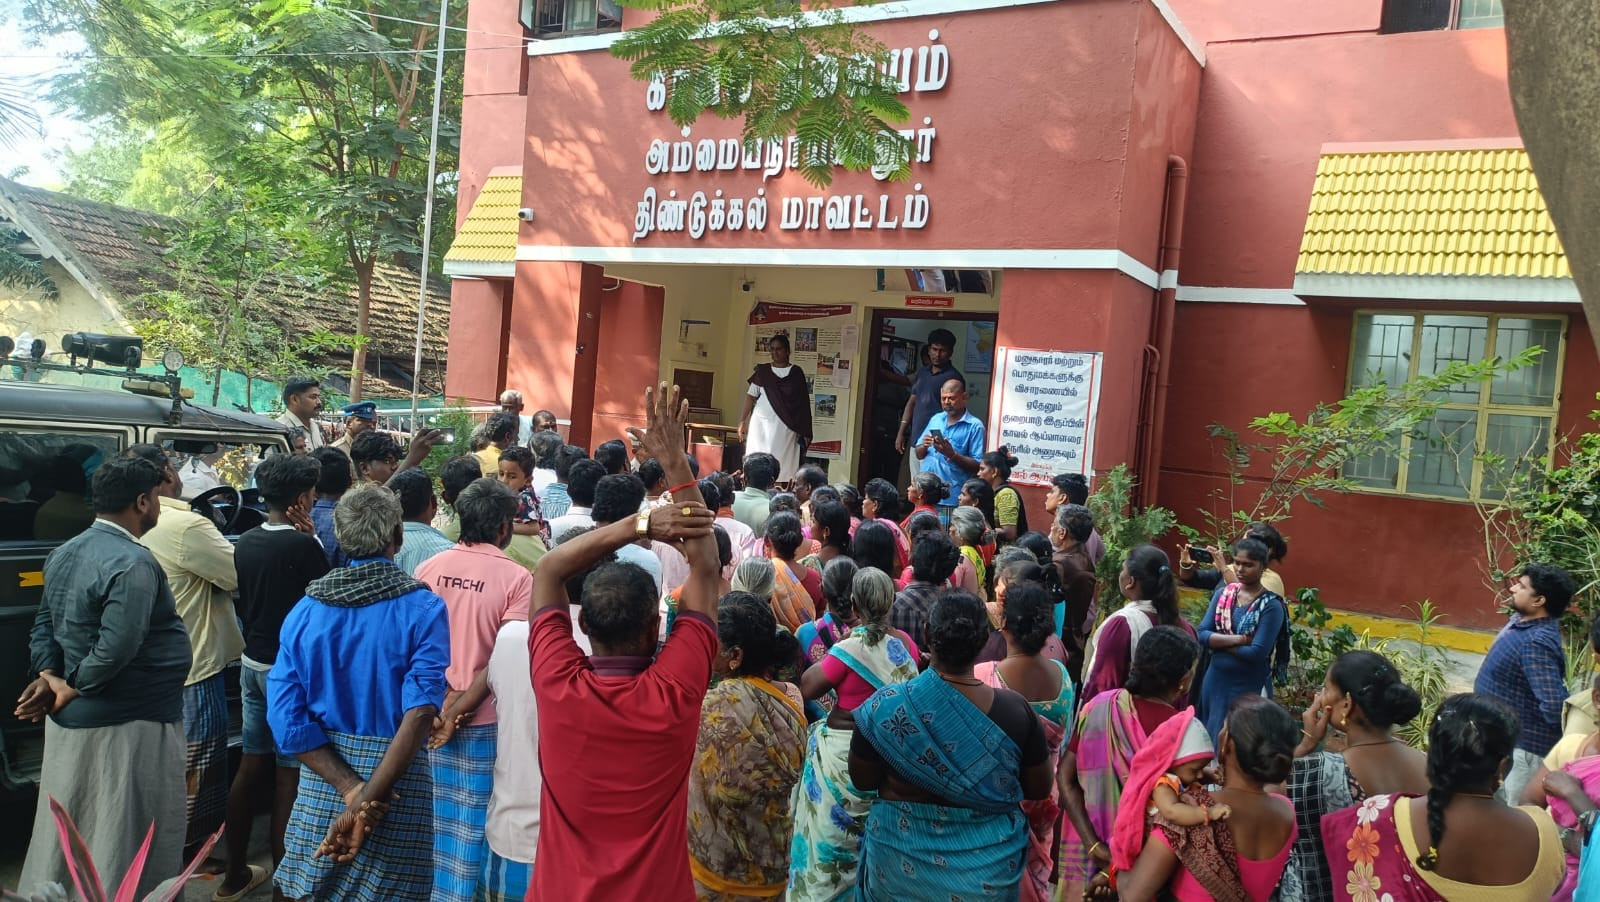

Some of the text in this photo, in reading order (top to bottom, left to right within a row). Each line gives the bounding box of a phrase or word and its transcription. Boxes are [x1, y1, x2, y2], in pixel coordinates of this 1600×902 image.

[632, 183, 931, 242] திண்டுக்கல் மாவட்டம்
[1054, 355, 1084, 368] மற்றும்
[1011, 369, 1084, 383] பொதுமக்களுக்கு
[1015, 383, 1078, 397] விசாரணையில்
[1026, 399, 1062, 414] ஏதேனும்
[1002, 414, 1085, 428] குறைபாடு இருப்பின்
[1002, 428, 1082, 445] காவல் ஆய்வாளரை
[1031, 445, 1077, 461] அணுகவும்
[436, 575, 486, 593] ITACHI
